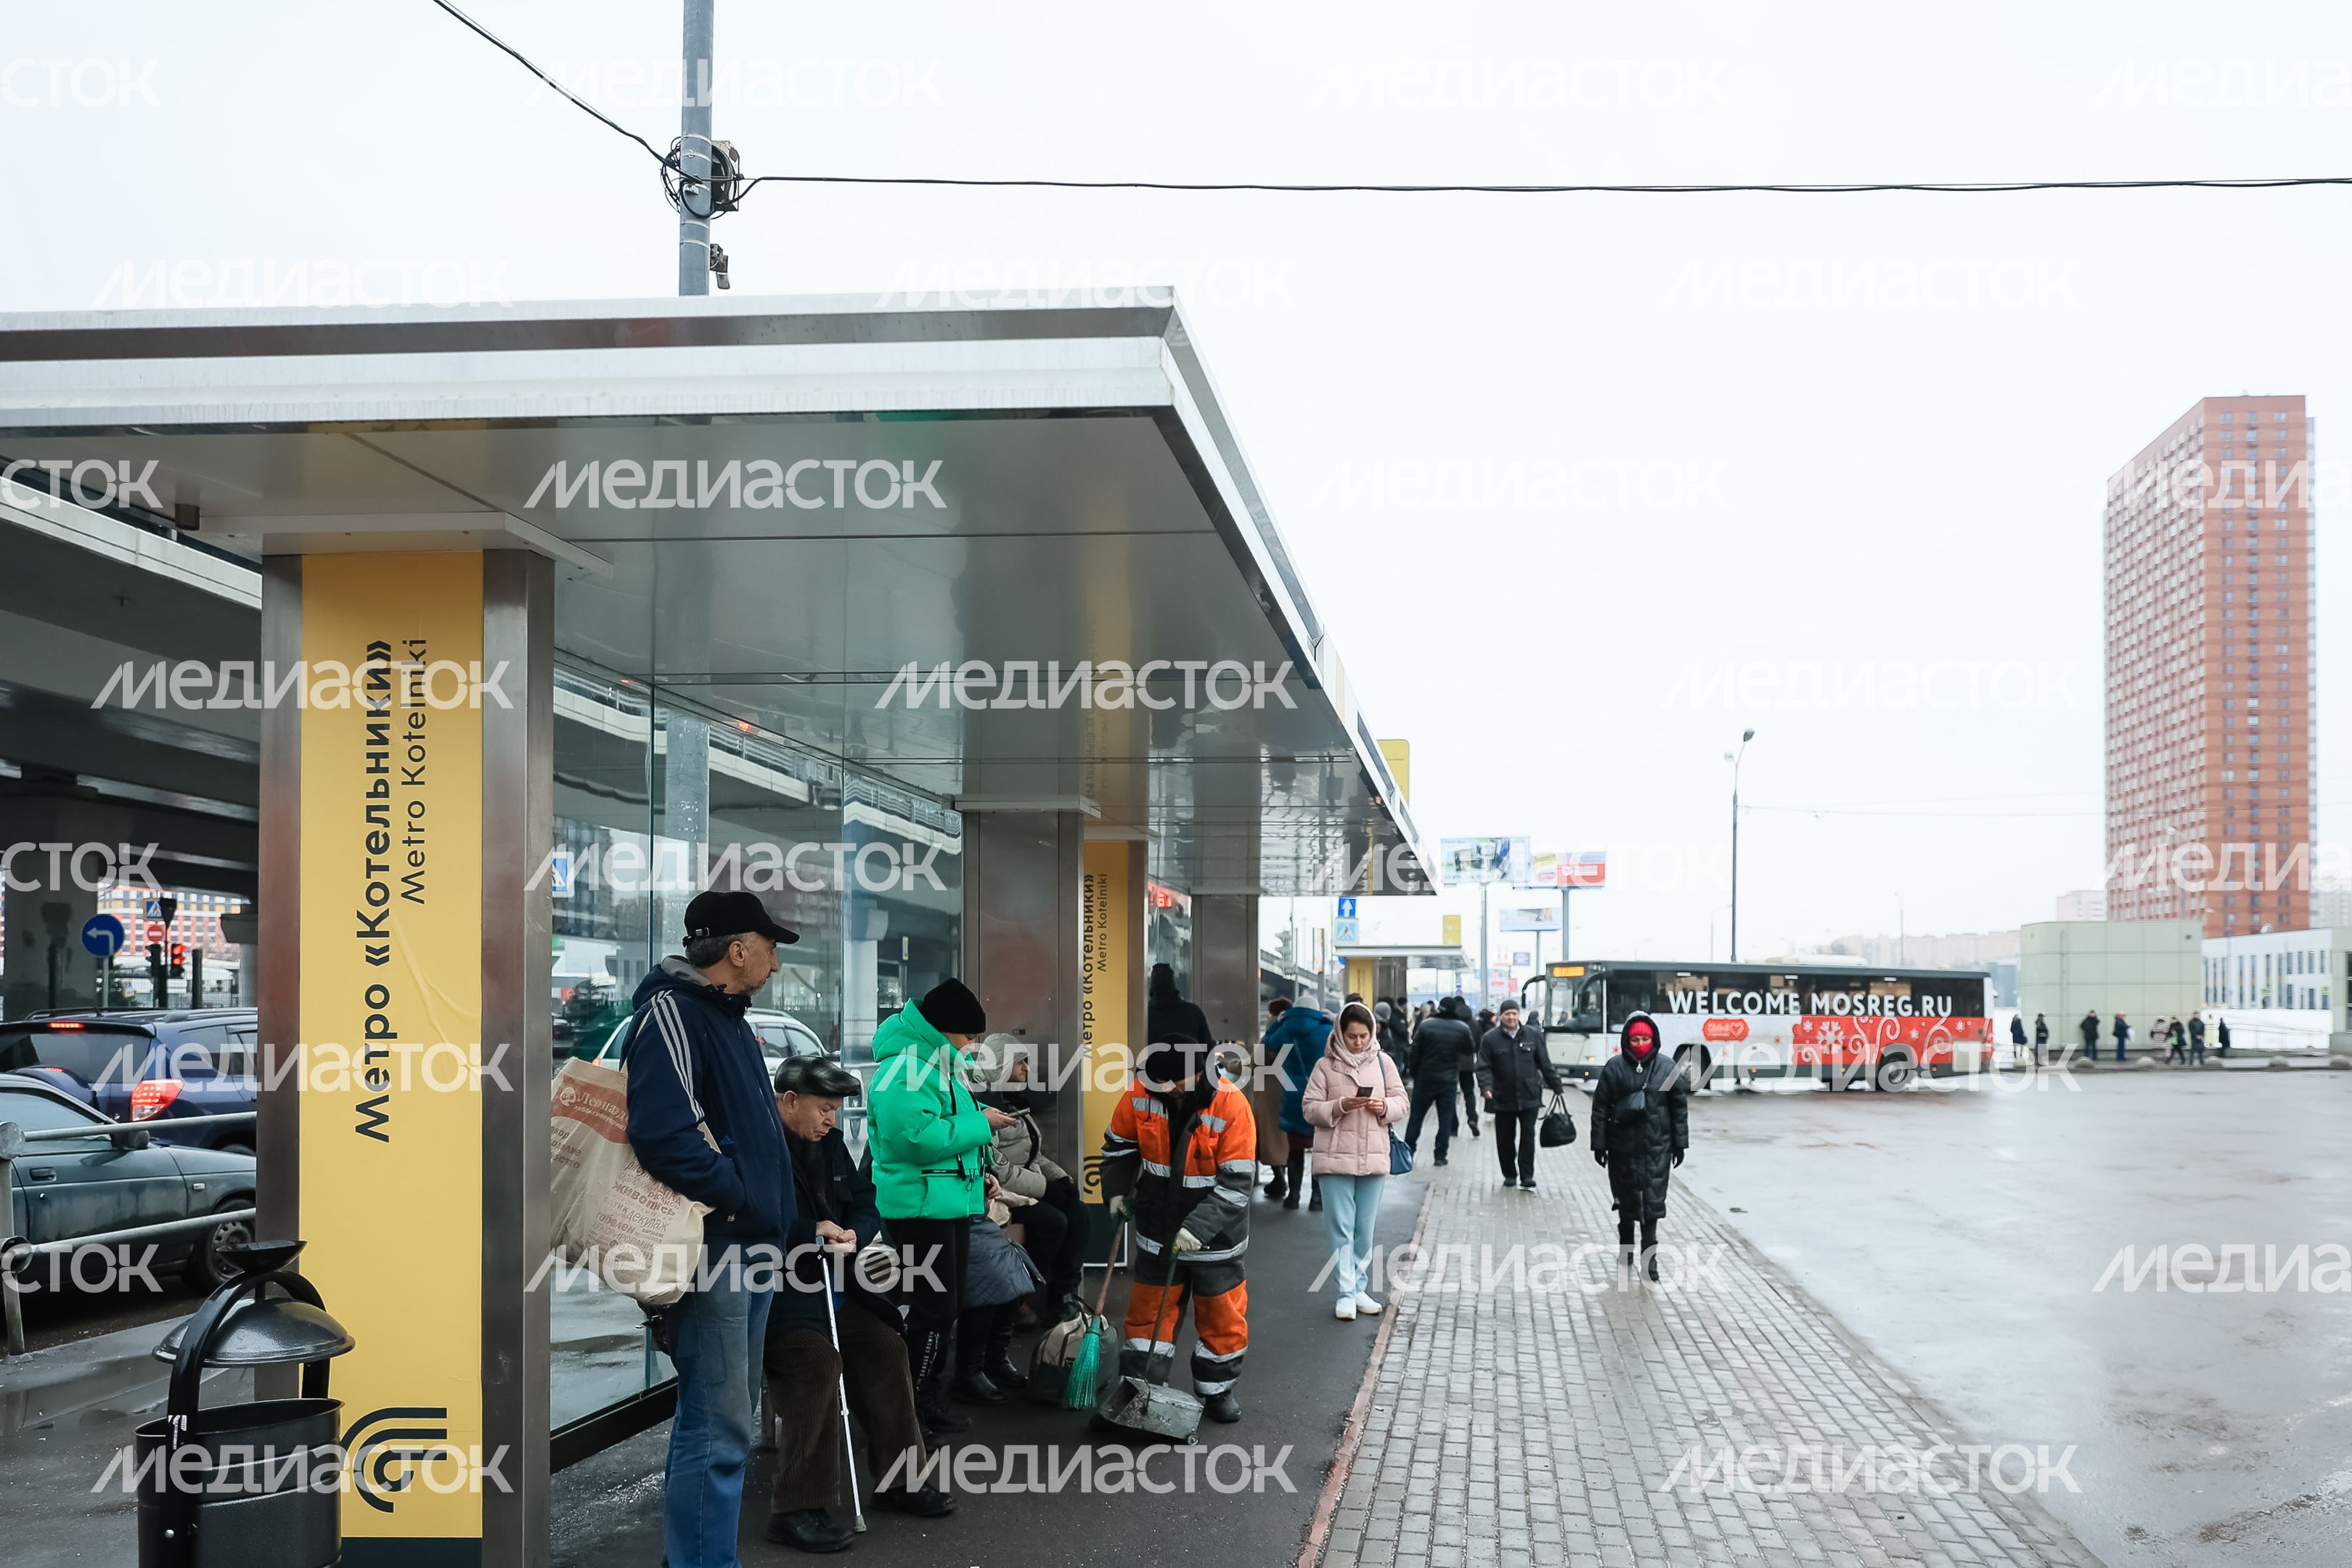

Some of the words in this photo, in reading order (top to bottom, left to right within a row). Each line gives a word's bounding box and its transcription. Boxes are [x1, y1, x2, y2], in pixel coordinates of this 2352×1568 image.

[401, 639, 427, 785] Kotelniki
[356, 640, 392, 966] «Котельники»
[400, 800, 427, 905] Metro
[1097, 873, 1107, 928] Kotelniki
[1097, 933, 1107, 972] Metro
[1669, 990, 1802, 1016] WELCOME
[1813, 992, 1953, 1018] MOSREG.RU
[355, 984, 398, 1143] Метро
